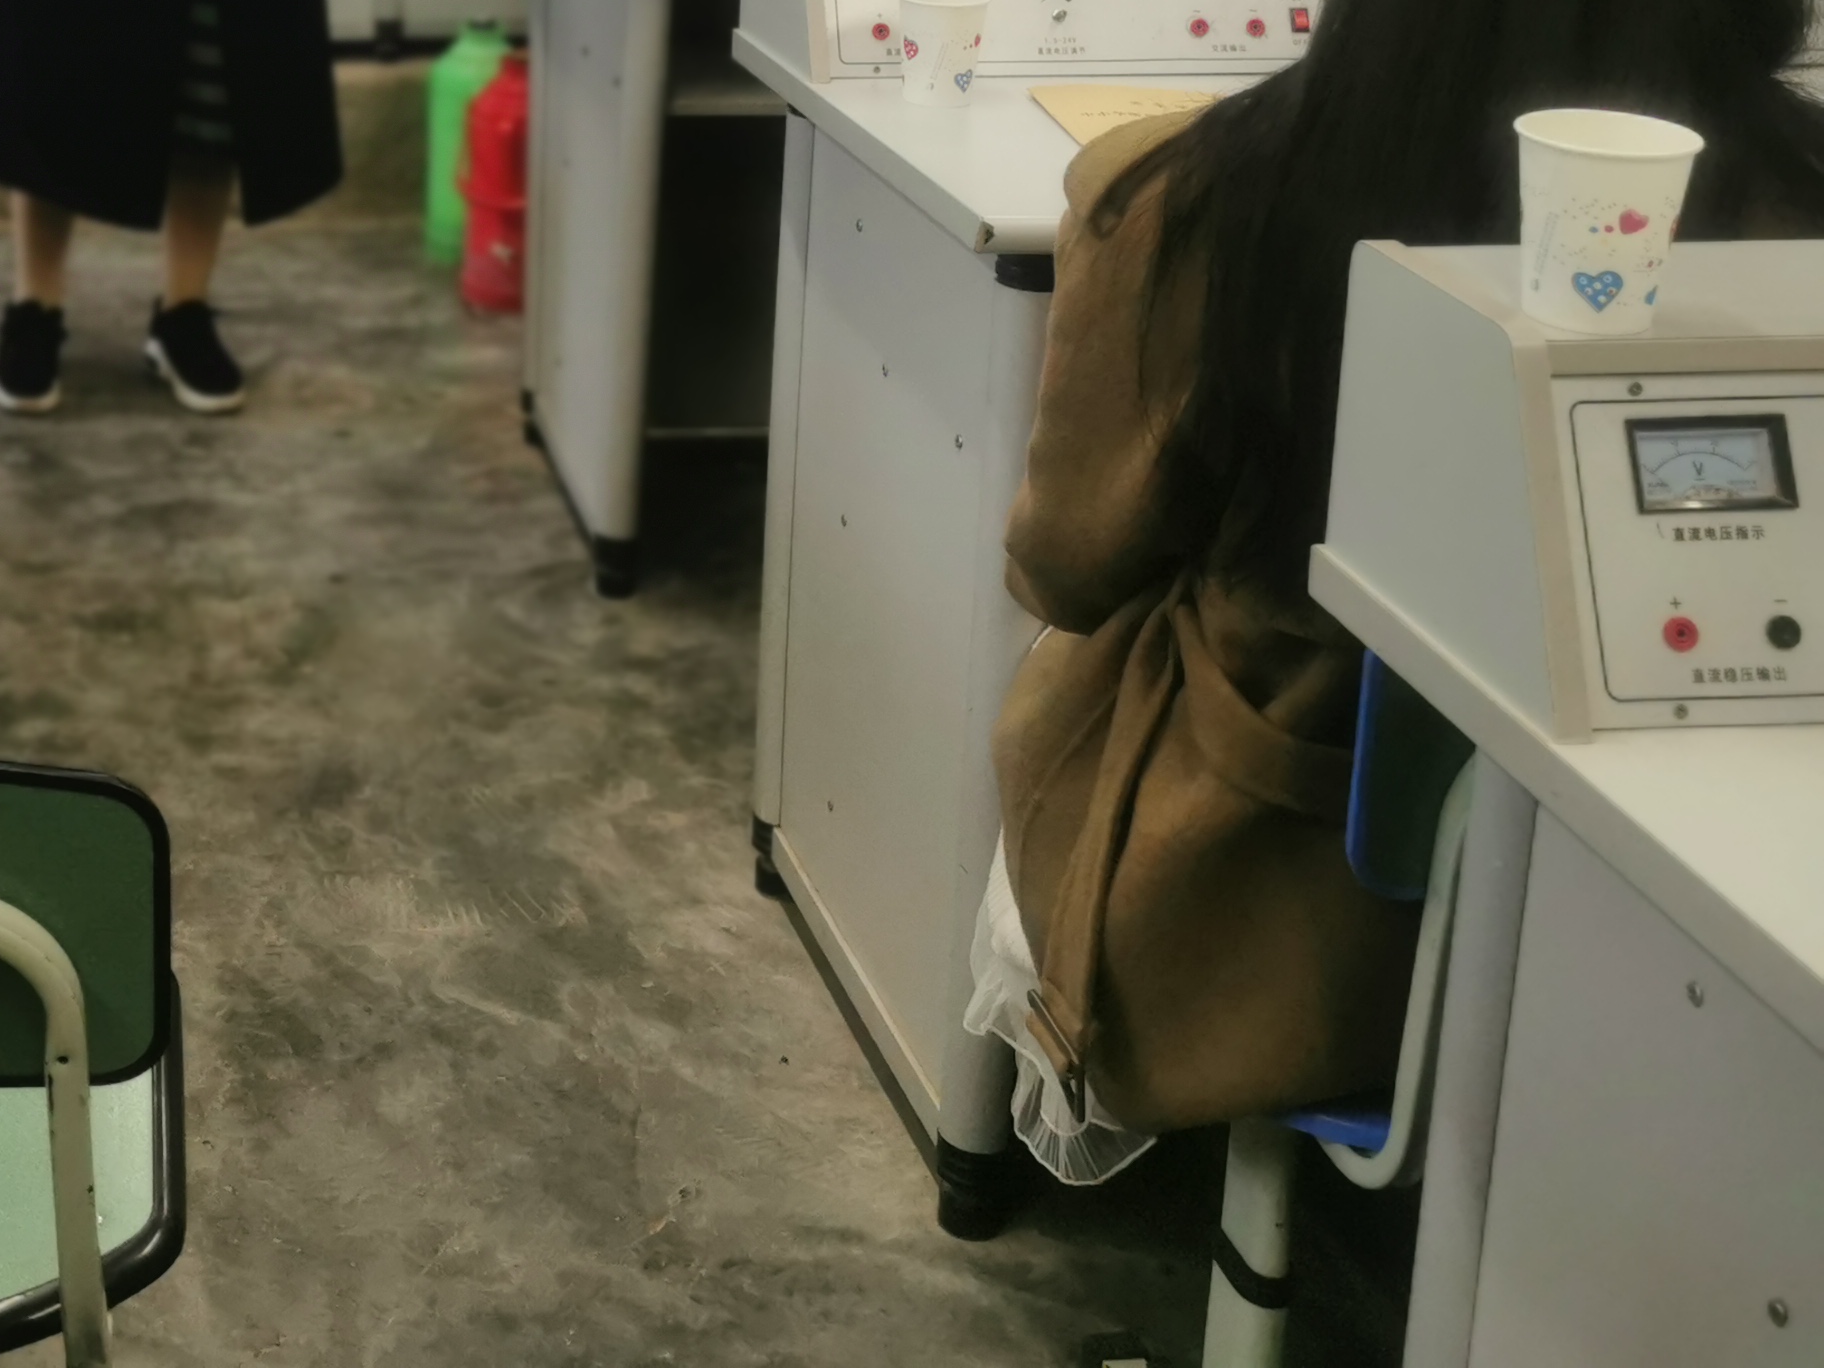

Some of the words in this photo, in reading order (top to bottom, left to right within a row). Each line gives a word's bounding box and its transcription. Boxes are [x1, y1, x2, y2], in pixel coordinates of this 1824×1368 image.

[1692, 460, 1703, 476] V
[1672, 525, 1765, 542] 直流电压指示
[1692, 666, 1787, 683] 直流稳压输出
